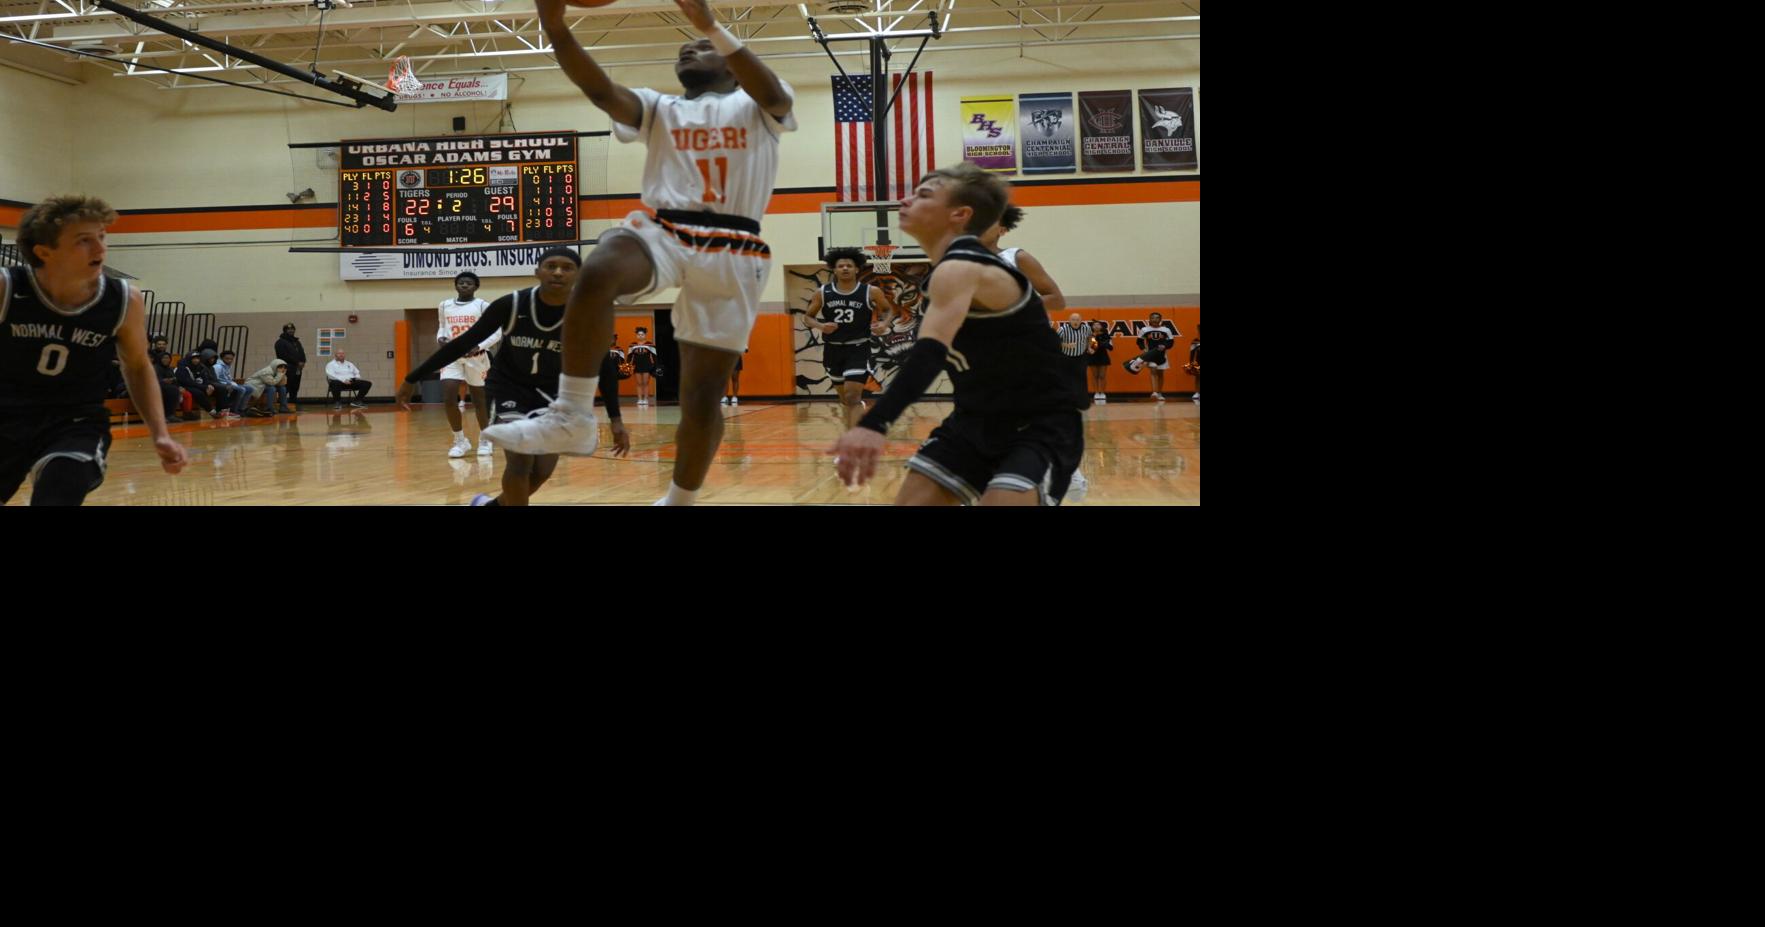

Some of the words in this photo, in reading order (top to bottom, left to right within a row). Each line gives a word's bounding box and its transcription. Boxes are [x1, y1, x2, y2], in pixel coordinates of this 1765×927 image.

[970, 114, 1002, 138] BHS
[348, 142, 431, 154] URBANA
[436, 139, 484, 151] HIGH
[490, 138, 569, 149] SCHOOL
[1084, 142, 1130, 150] CENTRAL
[1145, 138, 1192, 147] DANVILLE
[362, 154, 426, 166] OSCAR
[432, 151, 502, 164] ADAMS
[508, 149, 551, 161] GYM
[523, 166, 539, 174] PLY
[543, 165, 554, 174] FL
[556, 164, 574, 173] PTS
[343, 172, 358, 181] PLY
[362, 172, 372, 180] FL
[375, 171, 391, 180] PTS
[449, 168, 485, 184] 1:26
[532, 175, 540, 184] 0
[565, 174, 573, 183] 0
[696, 157, 727, 203] 11
[353, 182, 359, 191] 3
[382, 181, 390, 190] 0
[565, 185, 573, 195] 0
[348, 193, 359, 201] 11
[363, 192, 371, 201] 2
[400, 190, 431, 198] TIGERS
[484, 186, 514, 195] GUEST
[561, 196, 573, 204] 11
[348, 203, 359, 211] 14
[382, 202, 390, 211] 8
[405, 199, 430, 216] 22
[452, 199, 462, 212] 2
[489, 196, 514, 213] 29
[529, 208, 541, 216] 11
[545, 207, 553, 217] 0
[344, 213, 359, 223] 23
[382, 213, 390, 221] 4
[525, 218, 541, 228] 23
[545, 218, 553, 228] 0
[565, 217, 573, 227] 2
[344, 224, 359, 234] 40
[363, 224, 371, 233] 0
[382, 223, 390, 233] 0
[405, 223, 415, 236] 6
[424, 226, 431, 234] 4
[484, 224, 491, 232] 4
[506, 220, 515, 232] 7
[403, 252, 451, 269] DIMOND
[455, 249, 492, 267] BROS.
[496, 246, 550, 266] INSURA
[826, 299, 847, 309] NORMAL
[848, 300, 864, 309] WEST
[447, 315, 476, 324] TIGERS
[833, 308, 855, 324] 23
[10, 323, 65, 341] NORMAL
[70, 327, 107, 348] WEST
[510, 335, 545, 349] NORMAL
[36, 343, 70, 377] 0
[530, 352, 540, 375] 1
